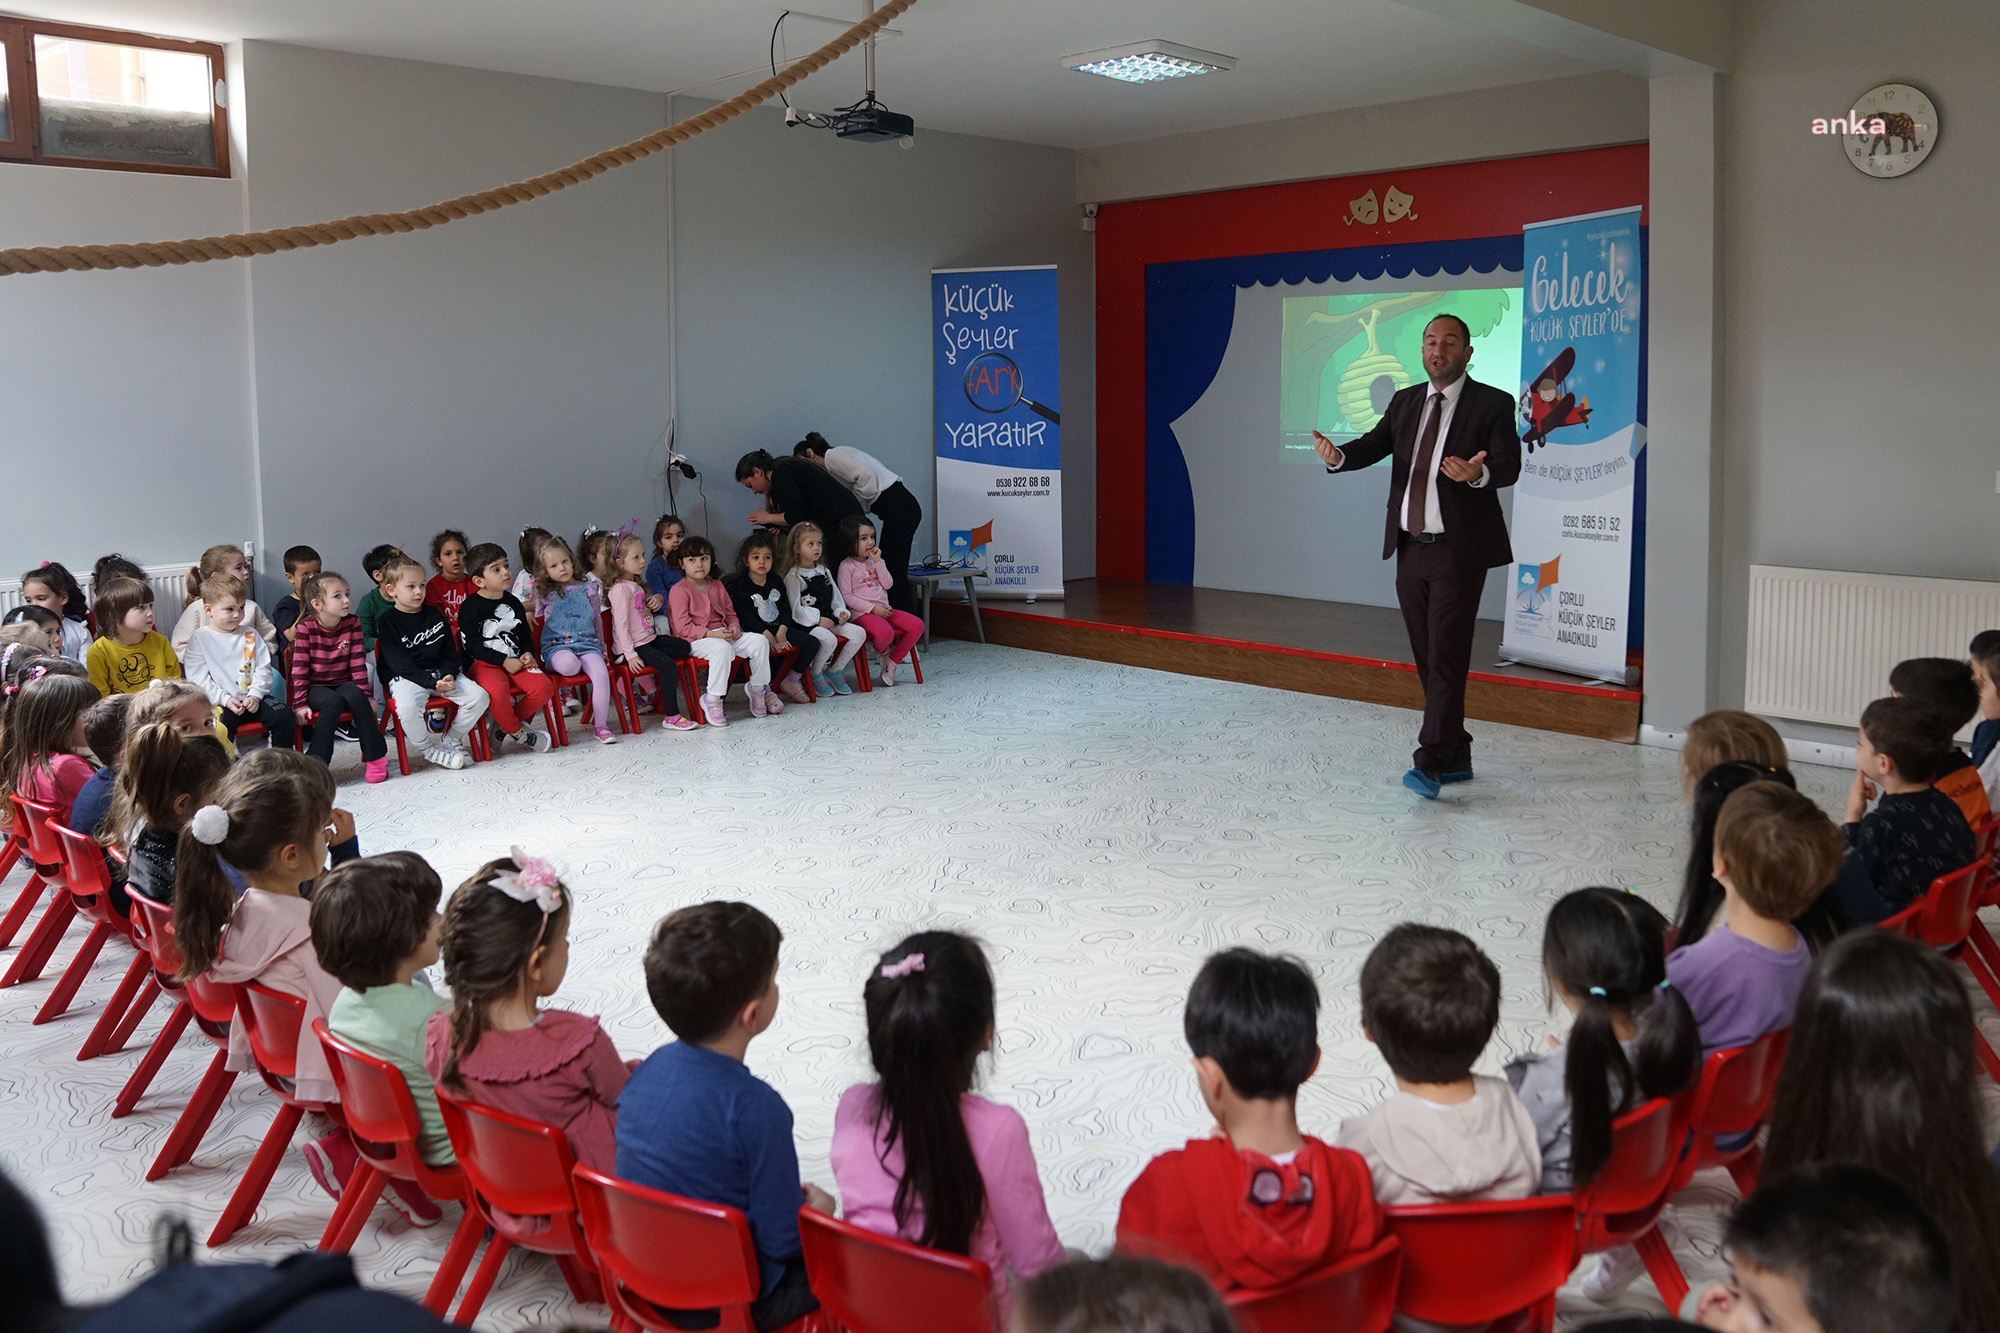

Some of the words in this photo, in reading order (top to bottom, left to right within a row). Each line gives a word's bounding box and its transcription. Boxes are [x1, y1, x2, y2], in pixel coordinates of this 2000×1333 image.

[1883, 90, 1895, 100] 12
[1919, 104, 1925, 114] 2
[1918, 140, 1925, 149] 4
[1855, 147, 1862, 157] 8
[1868, 158, 1875, 168] 7
[1904, 154, 1911, 164] 5
[1886, 161, 1893, 171] 6
[1531, 242, 1630, 313] Gelecek
[1530, 315, 1563, 344] KÜÇÜK
[1524, 459, 1537, 475] Ben
[1539, 464, 1548, 478] de
[1549, 463, 1572, 483] KÜÇÜK
[995, 478, 1012, 488] 0530
[1013, 476, 1027, 487] 922
[1029, 476, 1038, 487] 68
[1040, 476, 1050, 487] 68
[987, 489, 1050, 498] www.kucukseyler.com.tr
[1563, 515, 1579, 528] 0282
[1581, 514, 1596, 529] 685
[1598, 516, 1607, 530] 51
[1609, 517, 1620, 532] 52
[994, 554, 1015, 564] ÇORLU
[995, 564, 1015, 576] KÜÇÜK
[1016, 565, 1040, 576] ŞEYLER
[994, 577, 1027, 586] ANAOKULU
[1559, 591, 1584, 607] ÇORLU
[1558, 608, 1584, 628] KÜÇÜK
[1586, 614, 1616, 631] ŞEYLER
[1557, 629, 1598, 648] ANAOKULU
